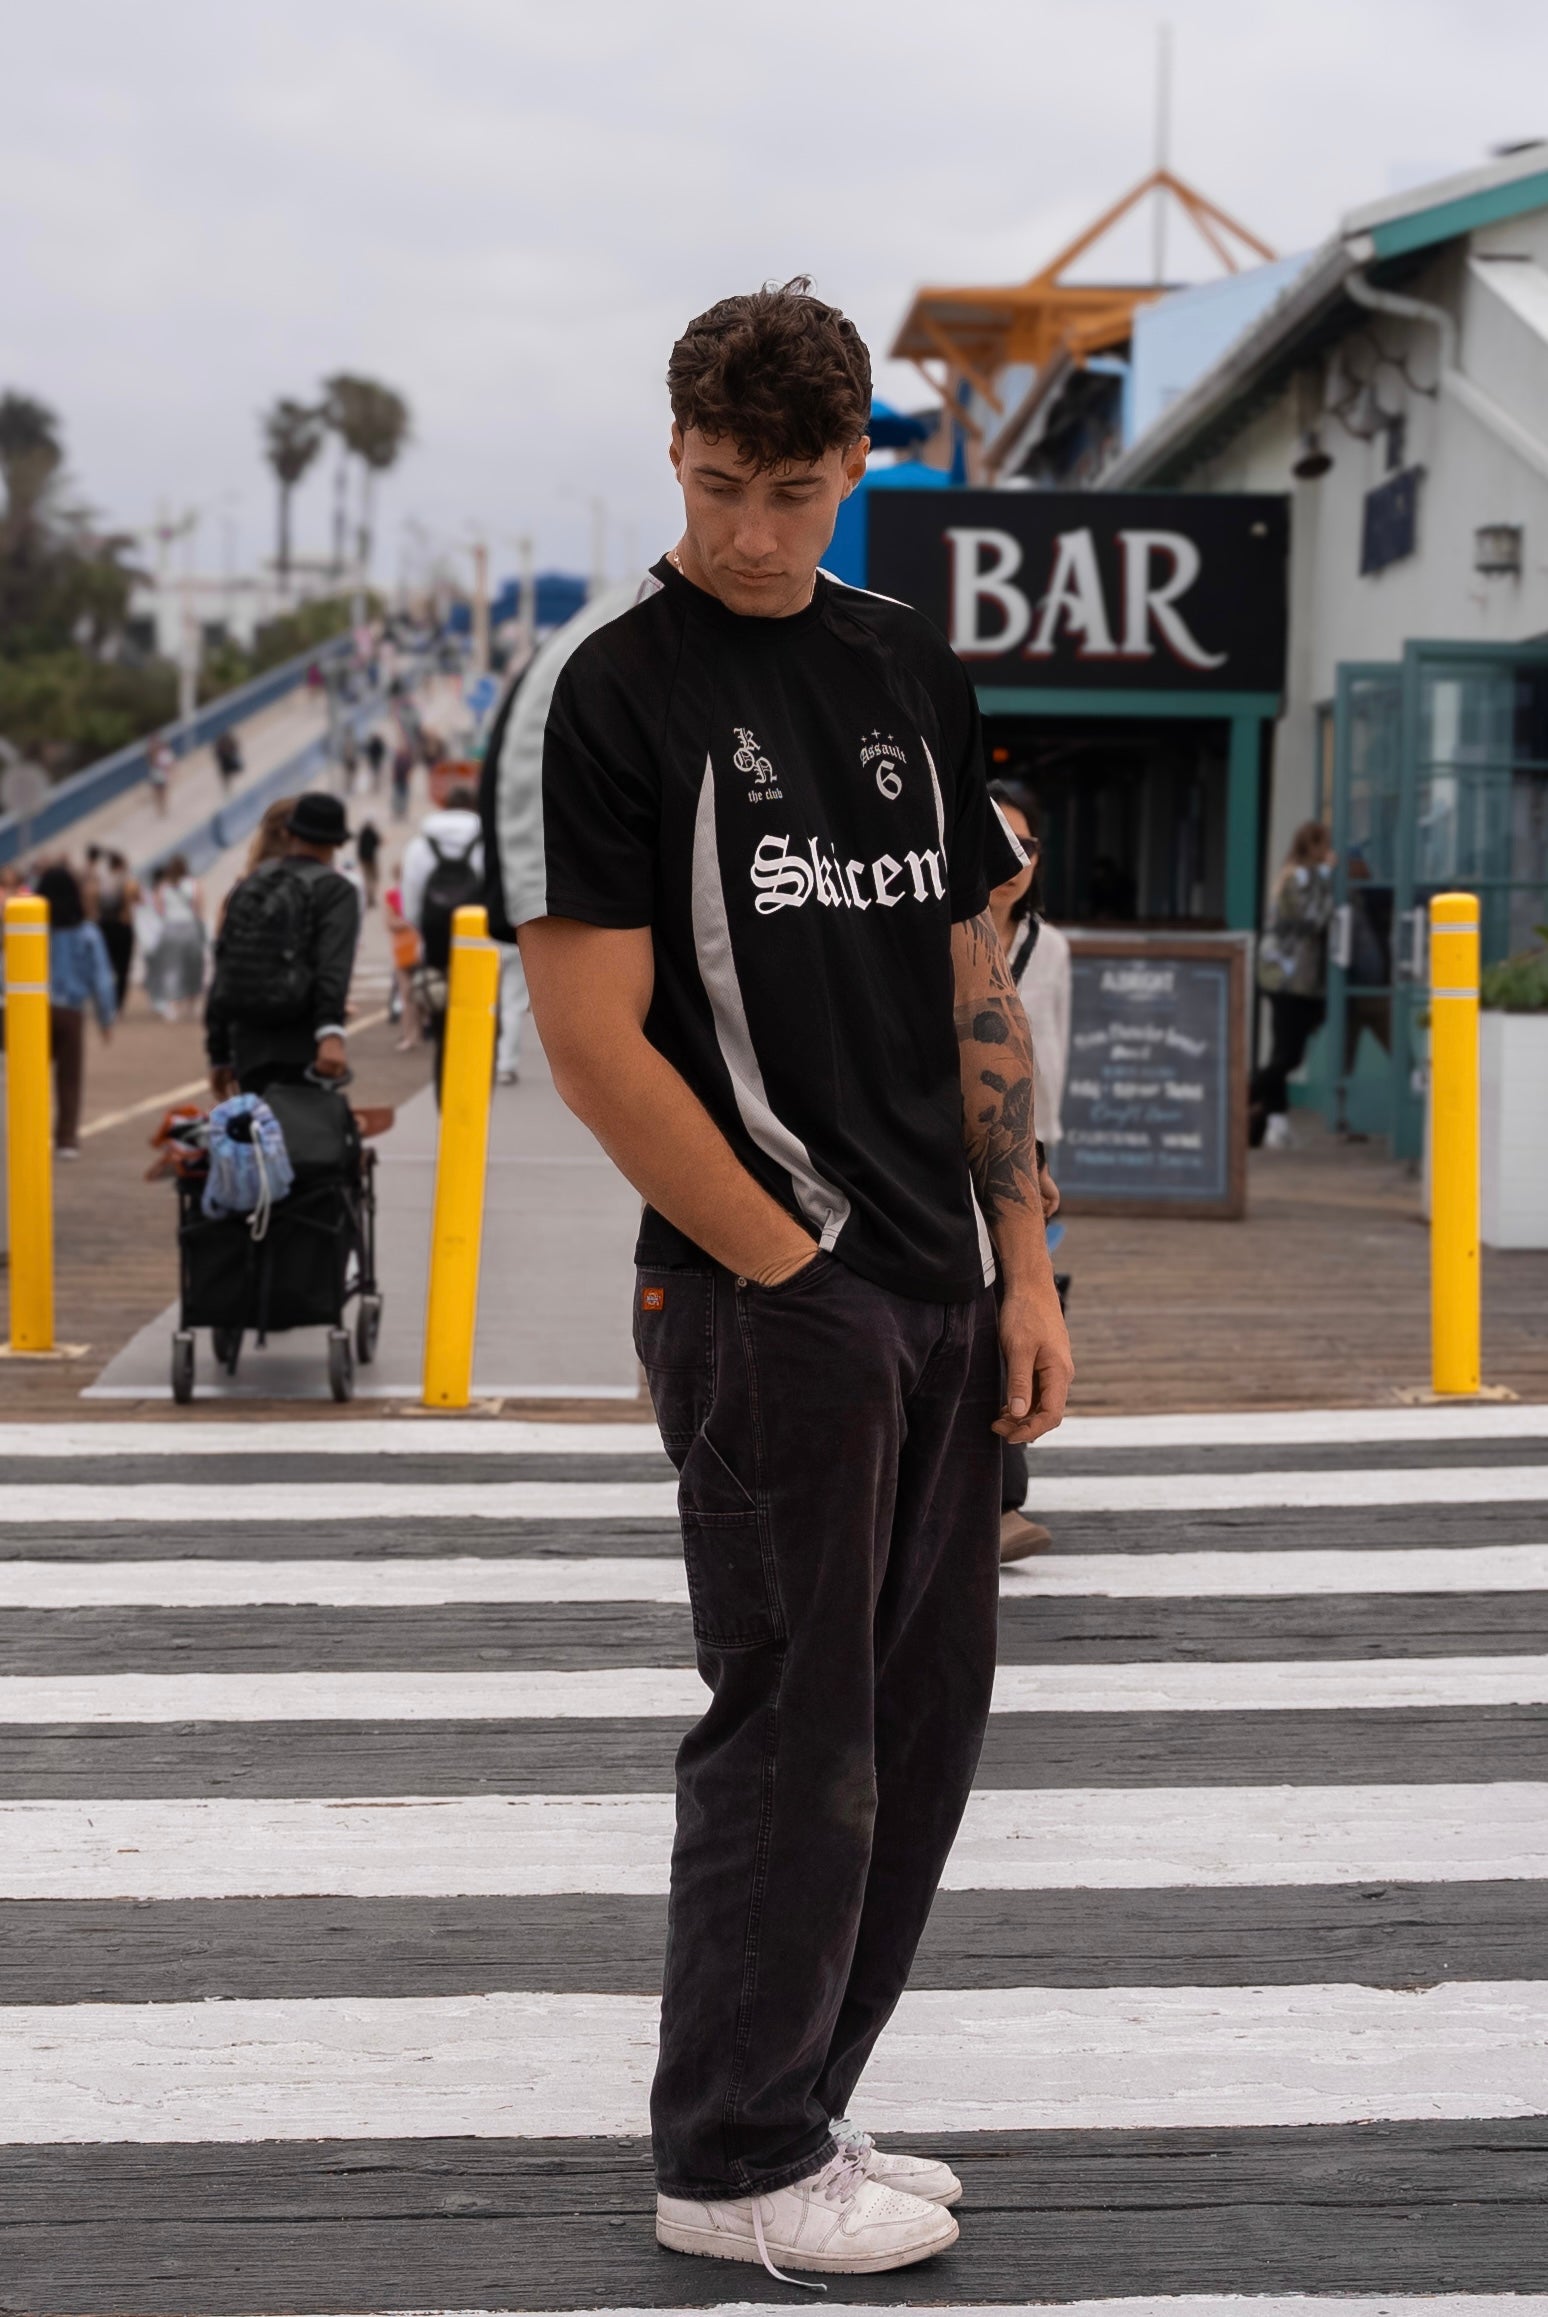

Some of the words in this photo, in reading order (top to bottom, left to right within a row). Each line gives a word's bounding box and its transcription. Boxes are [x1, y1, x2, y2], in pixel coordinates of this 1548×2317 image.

[943, 526, 1229, 670] BAR
[859, 743, 907, 769] Assault
[747, 790, 763, 803] the
[875, 759, 903, 801] 6
